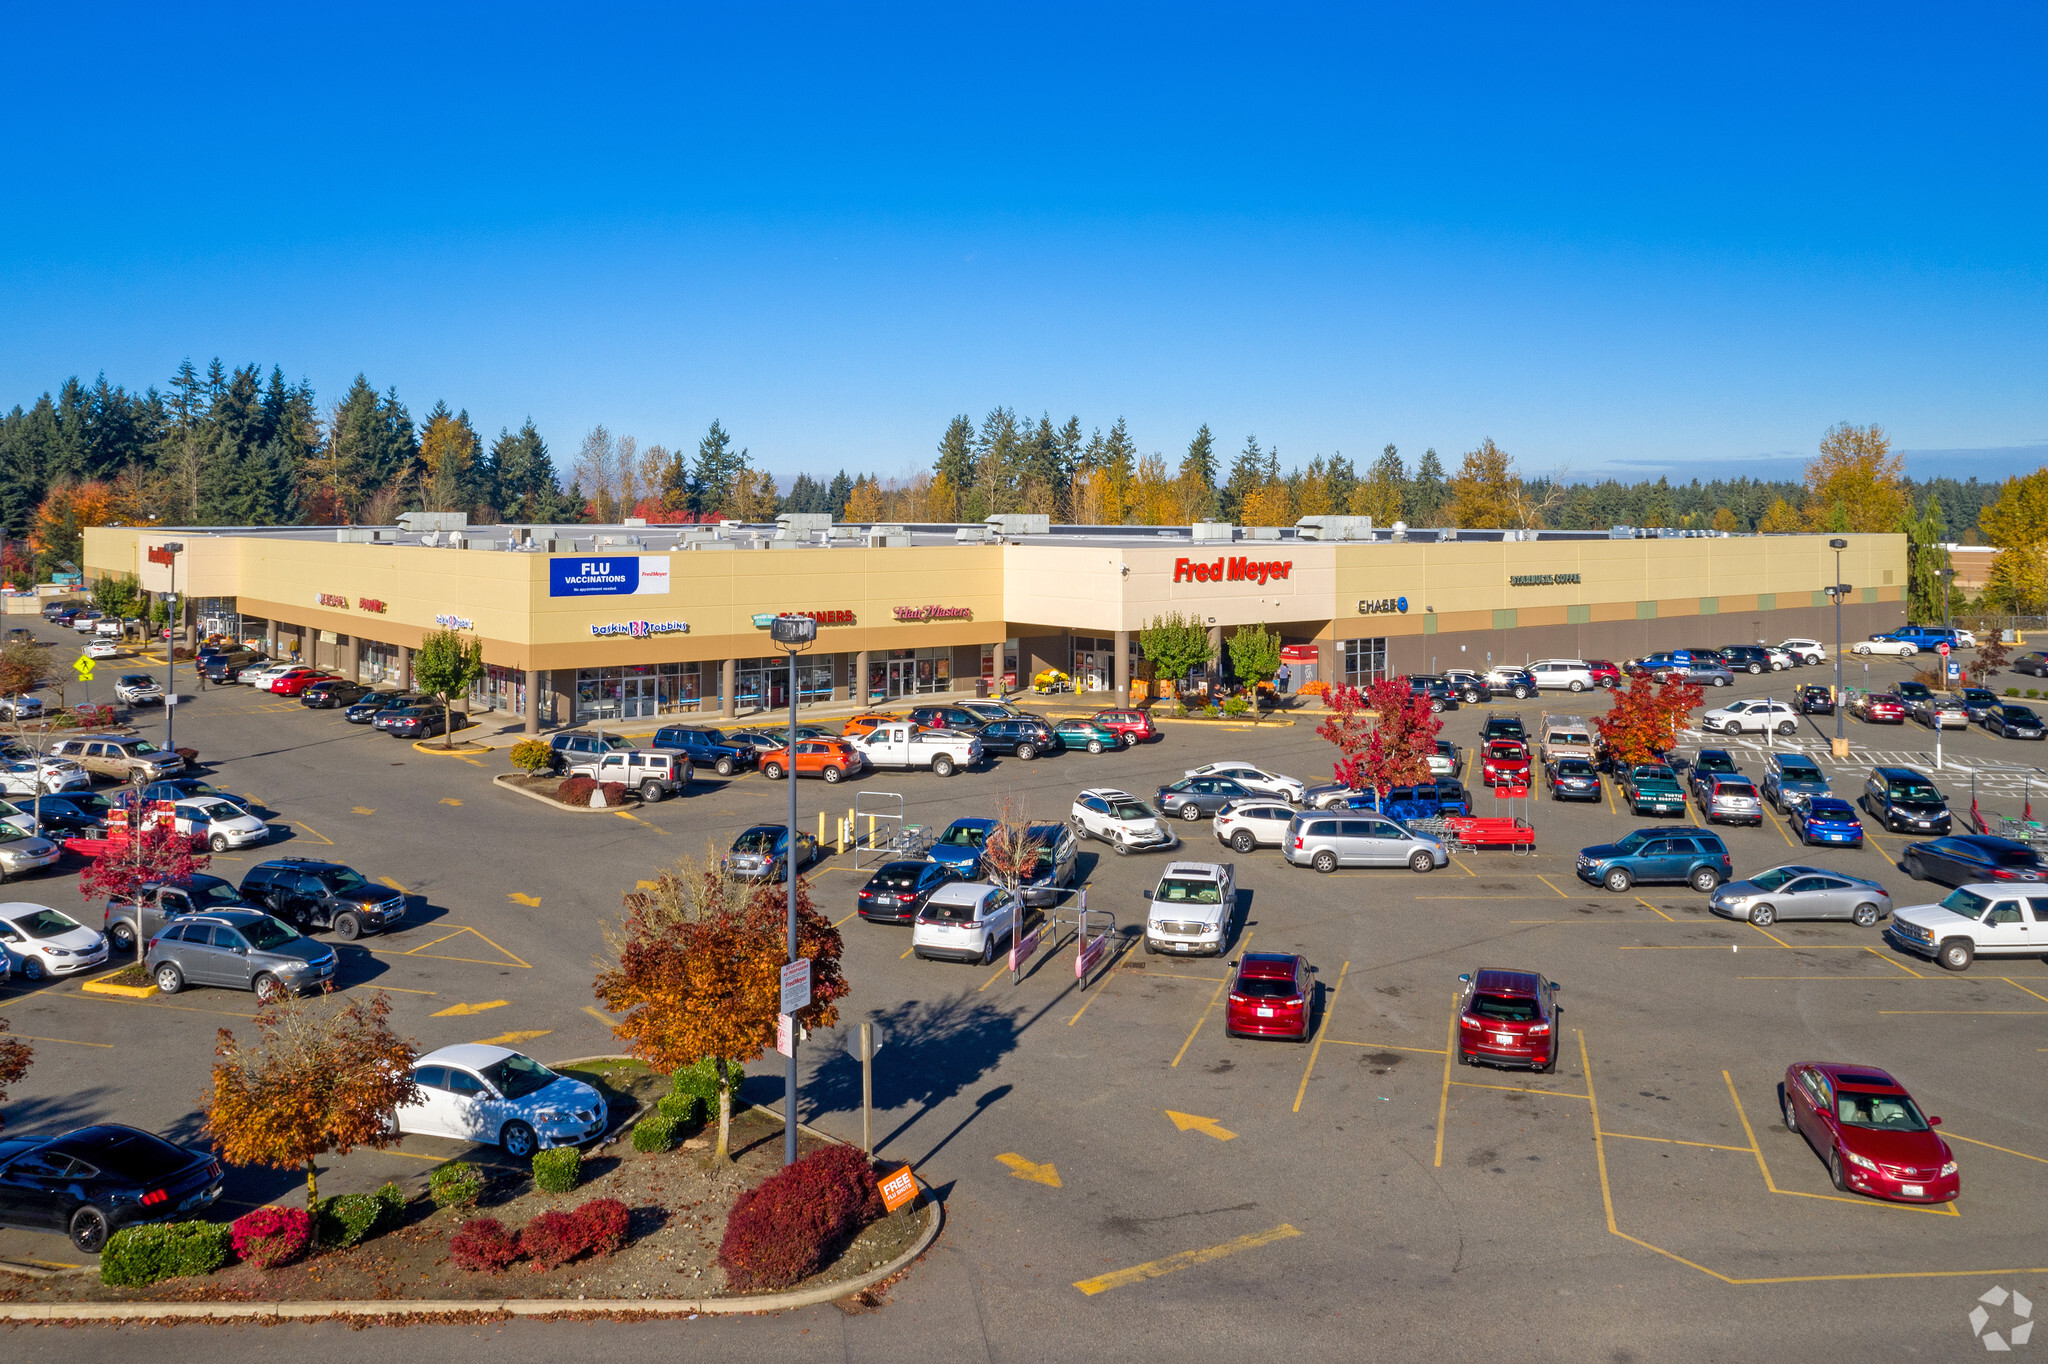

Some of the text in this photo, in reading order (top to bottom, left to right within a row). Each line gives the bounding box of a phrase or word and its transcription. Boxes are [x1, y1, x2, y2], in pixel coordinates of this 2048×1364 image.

[581, 562, 610, 575] FLU
[1174, 556, 1293, 586] Fred Meyer
[565, 575, 626, 584] VACCINATIONS
[1511, 573, 1581, 585] STARBUCKS COFFEE
[1358, 598, 1396, 612] CHASE
[780, 609, 853, 622] ANERS
[591, 620, 687, 636] baskin BR robbins
[883, 1172, 911, 1196] FREE
[887, 1192, 897, 1201] FLU
[896, 1183, 912, 1195] SHOTS
